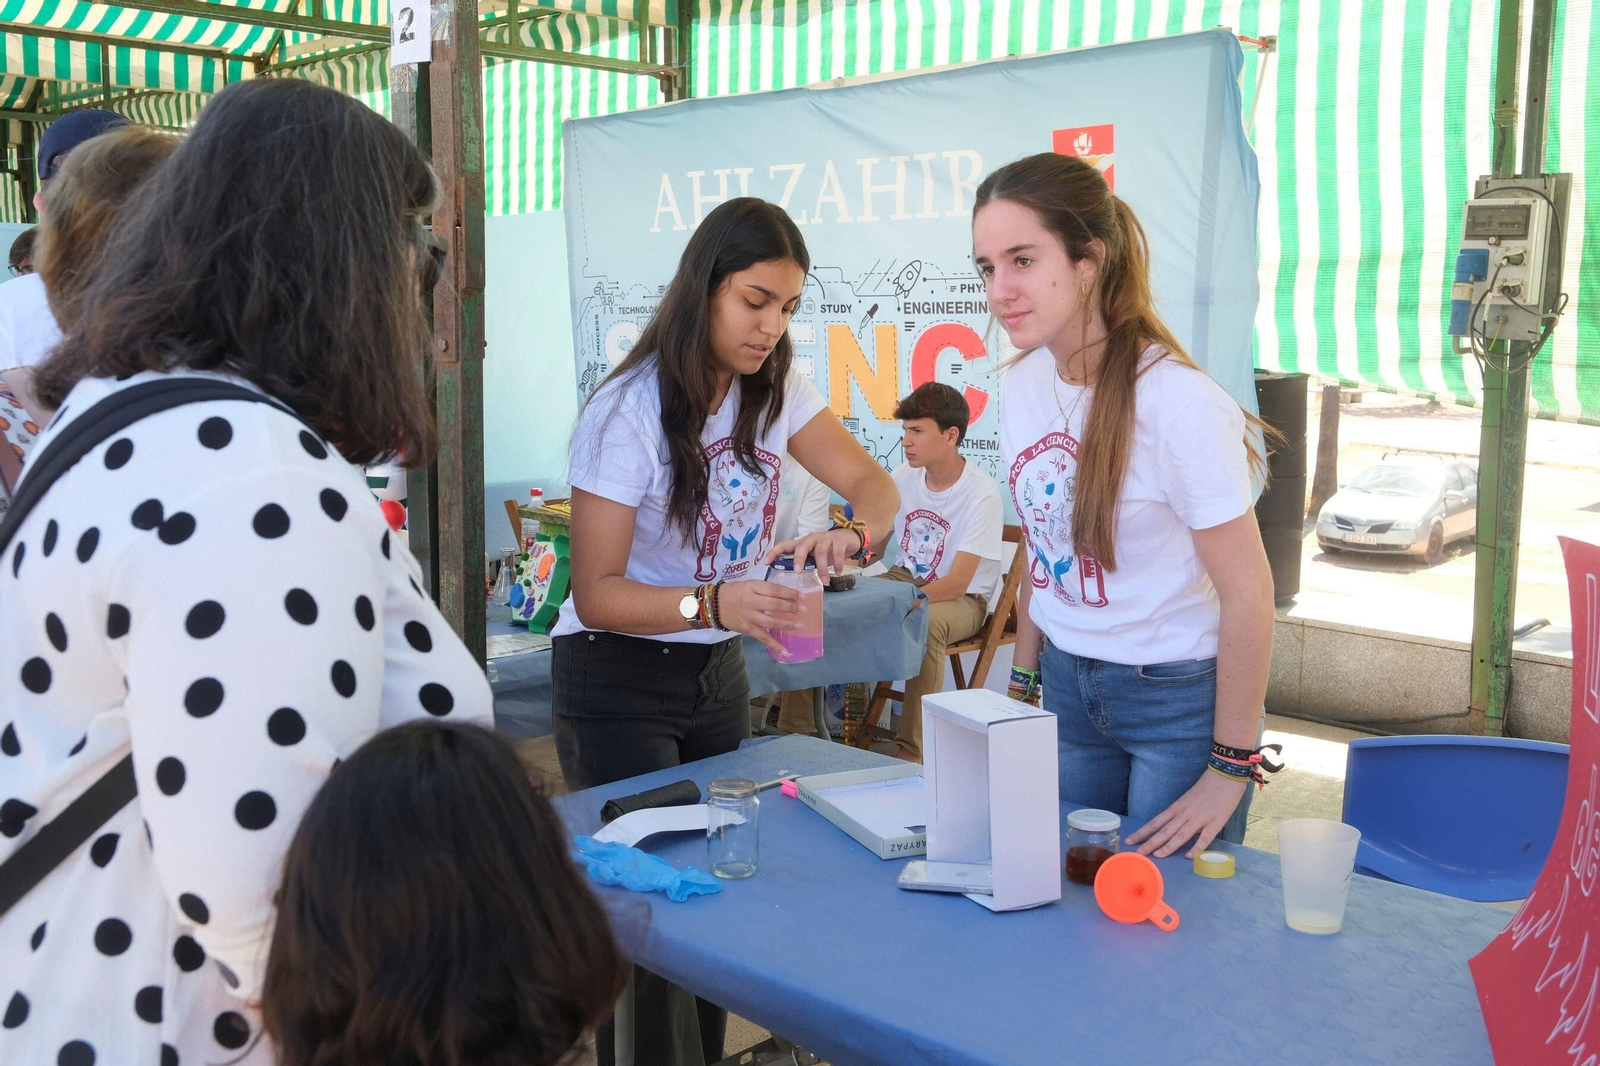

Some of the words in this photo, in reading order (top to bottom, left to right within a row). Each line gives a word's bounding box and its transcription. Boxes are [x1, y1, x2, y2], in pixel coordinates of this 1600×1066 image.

[398, 7, 415, 44] 2
[618, 306, 655, 315] TECHNOLO
[820, 303, 852, 314] STUDY
[903, 301, 990, 314] ENGINEERIN
[959, 438, 1000, 451] ATHEM
[1011, 457, 1027, 479] POR
[1031, 443, 1046, 457] LA
[1046, 434, 1077, 455] CIENCIA
[890, 839, 926, 852] ARYPAZ
